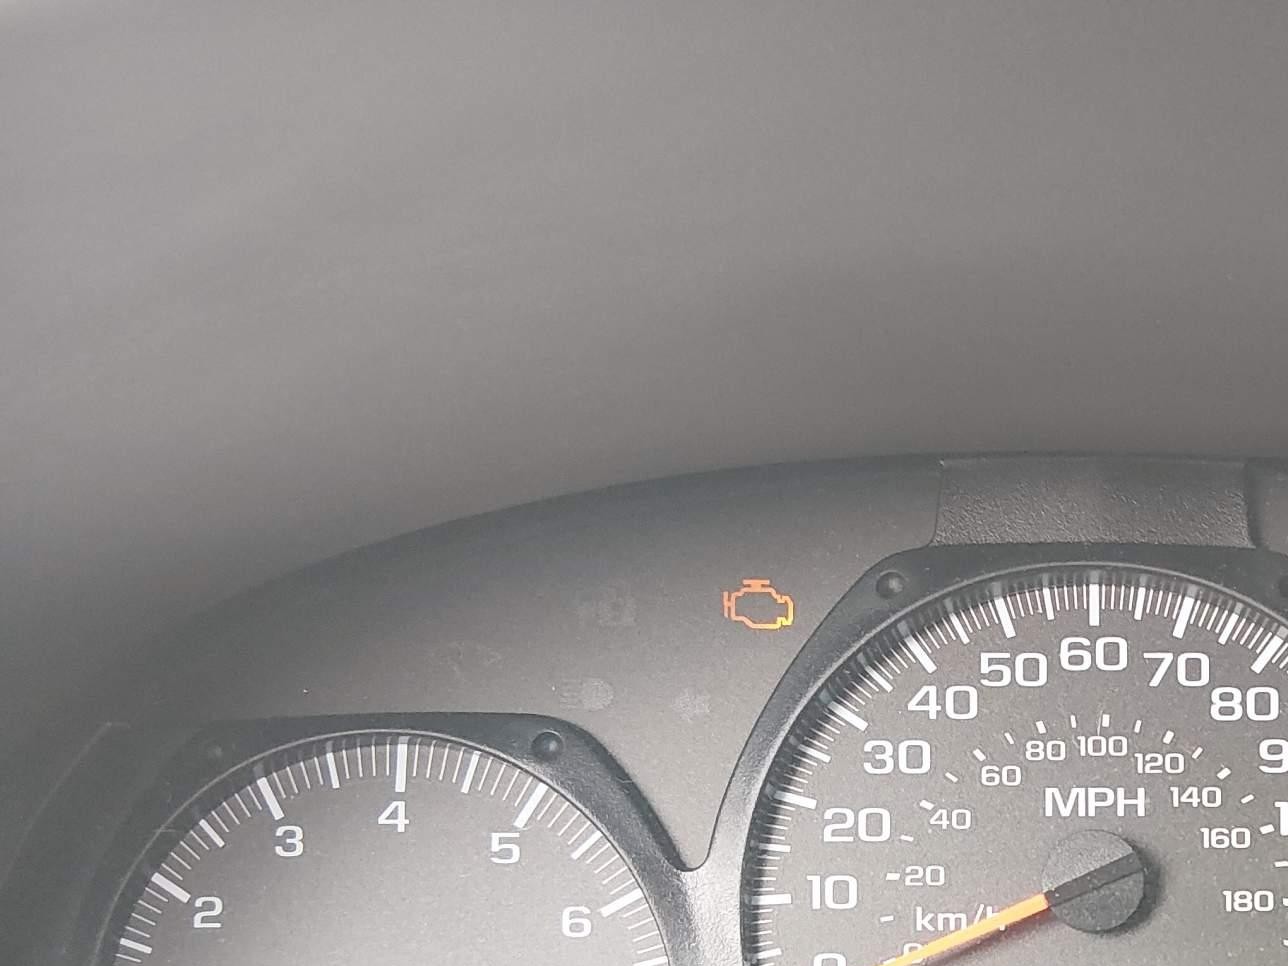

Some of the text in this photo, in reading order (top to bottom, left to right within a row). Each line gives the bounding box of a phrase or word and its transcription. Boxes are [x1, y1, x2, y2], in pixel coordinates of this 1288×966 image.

[980, 652, 1048, 687] 50
[1059, 636, 1128, 671] 60
[1143, 652, 1210, 687] 70
[907, 685, 978, 720] 40
[1210, 686, 1279, 721] 80
[863, 739, 931, 775] 30
[1025, 740, 1066, 761] 80
[1076, 735, 1128, 757] 100
[981, 765, 1022, 786] 60
[1134, 752, 1185, 774] 120
[1045, 787, 1146, 817] MPH
[1170, 786, 1222, 808] 140
[377, 800, 410, 833] 4
[823, 807, 891, 842] 20
[929, 809, 972, 831] 40
[274, 825, 304, 857] 3
[490, 832, 521, 864] 5
[1199, 827, 1251, 849] 160
[904, 865, 945, 886] 20
[806, 875, 858, 910] 10
[1222, 890, 1274, 912] 180
[193, 896, 223, 929] 2
[561, 905, 592, 938] 6
